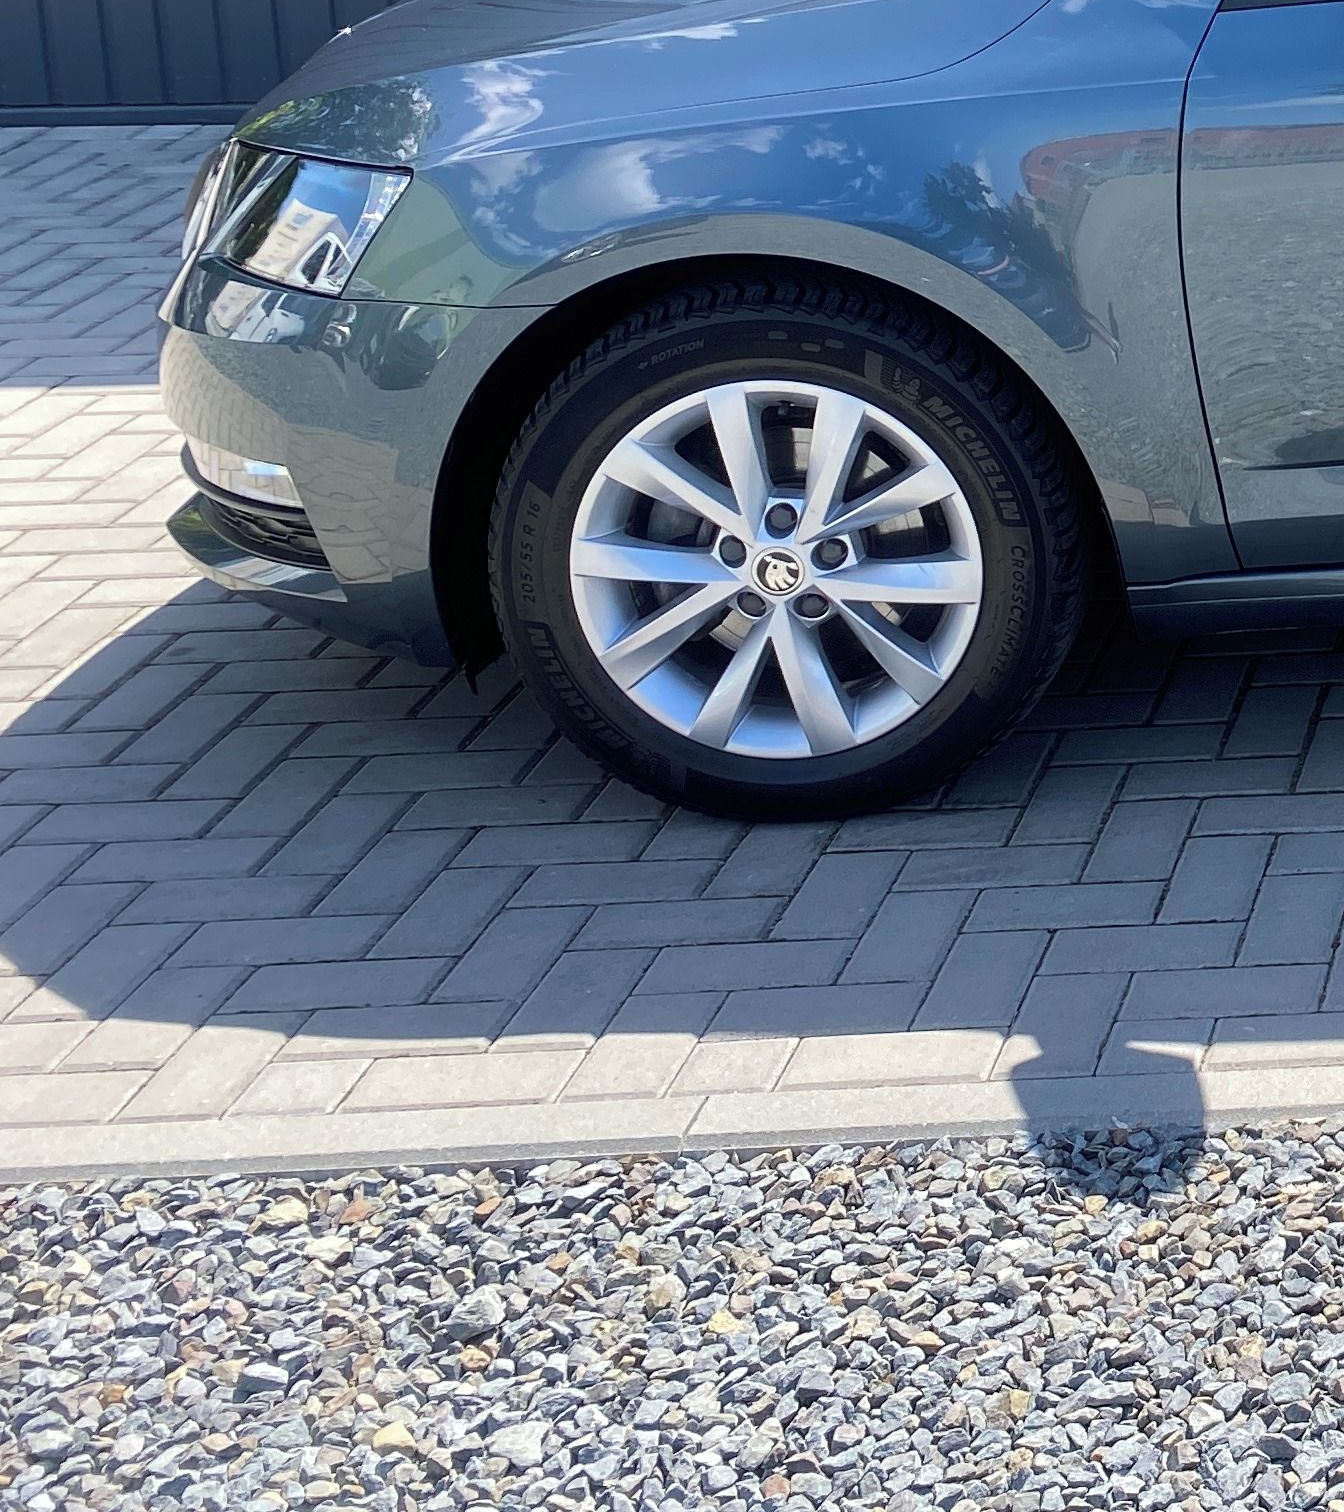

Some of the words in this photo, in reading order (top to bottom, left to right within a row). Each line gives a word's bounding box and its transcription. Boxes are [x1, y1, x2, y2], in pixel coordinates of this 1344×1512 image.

[650, 339, 704, 365] ROTATION
[923, 396, 1021, 521] MICHELIN
[527, 501, 541, 520] 16
[524, 525, 536, 537] R
[519, 543, 536, 603] 205/55
